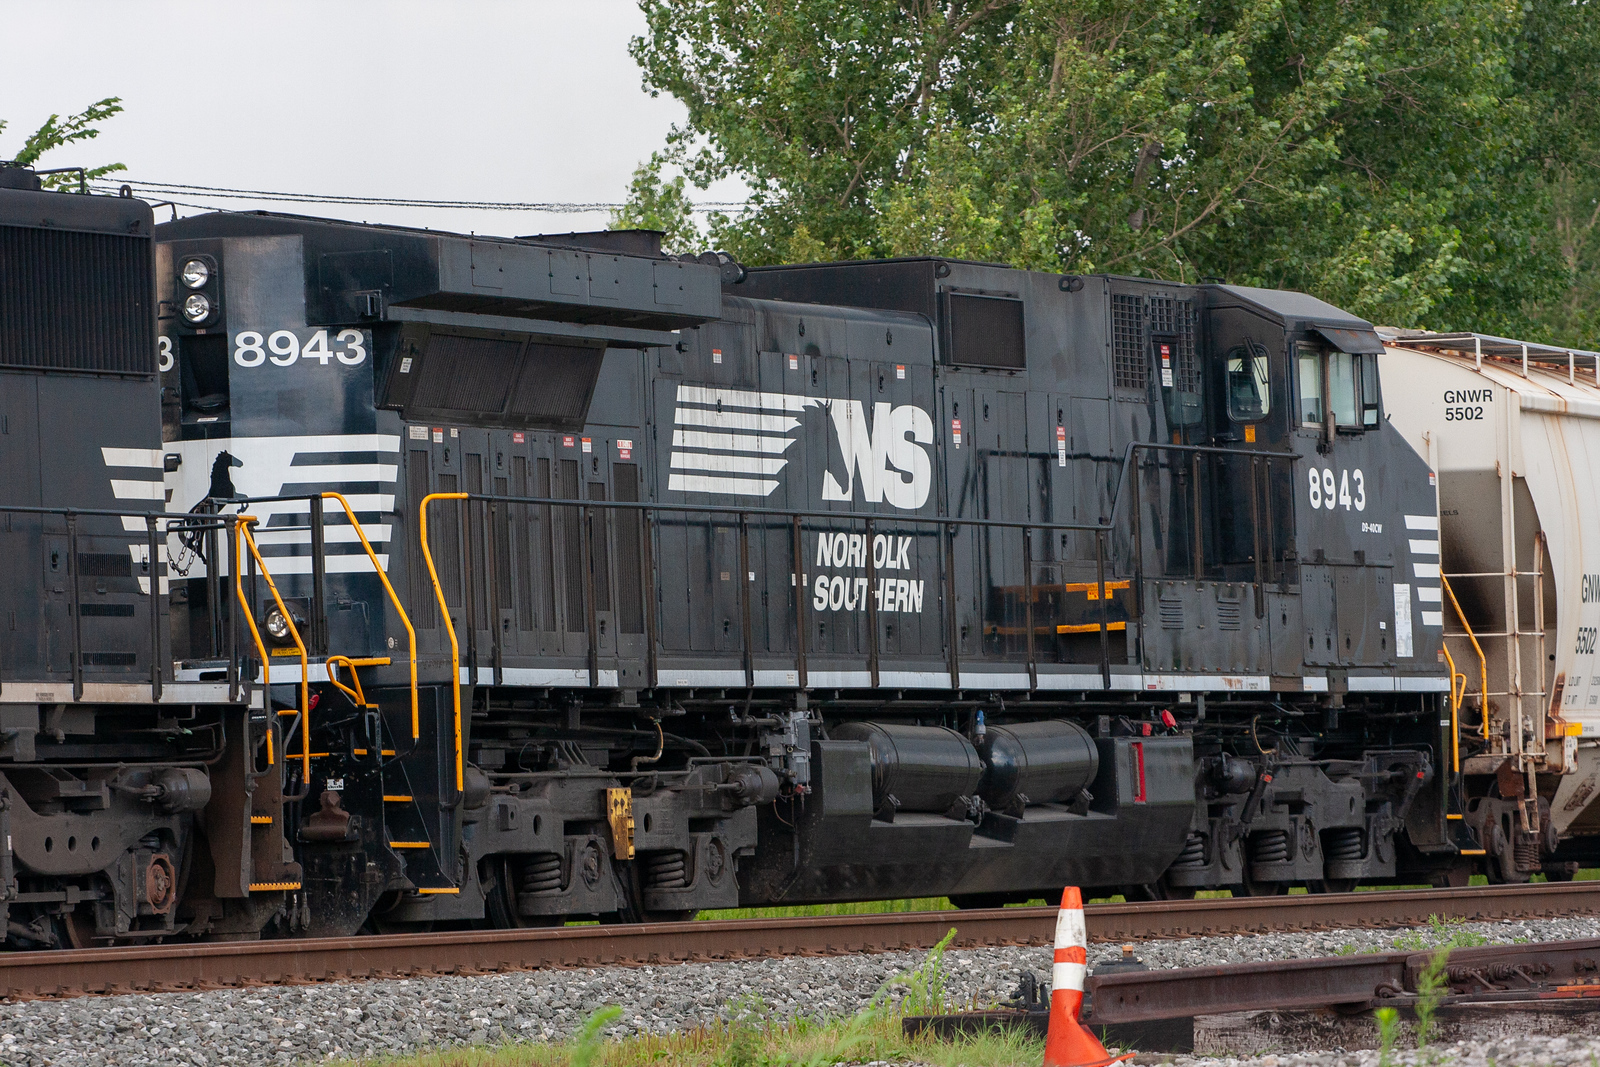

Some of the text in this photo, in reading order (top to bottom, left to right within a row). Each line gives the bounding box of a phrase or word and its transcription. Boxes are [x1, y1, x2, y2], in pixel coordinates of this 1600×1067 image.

[234, 329, 366, 367] 8943
[1443, 389, 1493, 404] GNWR
[1445, 406, 1484, 421] 5502
[821, 398, 934, 510] NS
[1308, 467, 1366, 512] 8943
[813, 575, 925, 613] SOUTHERN
[1575, 626, 1598, 655] 5502
